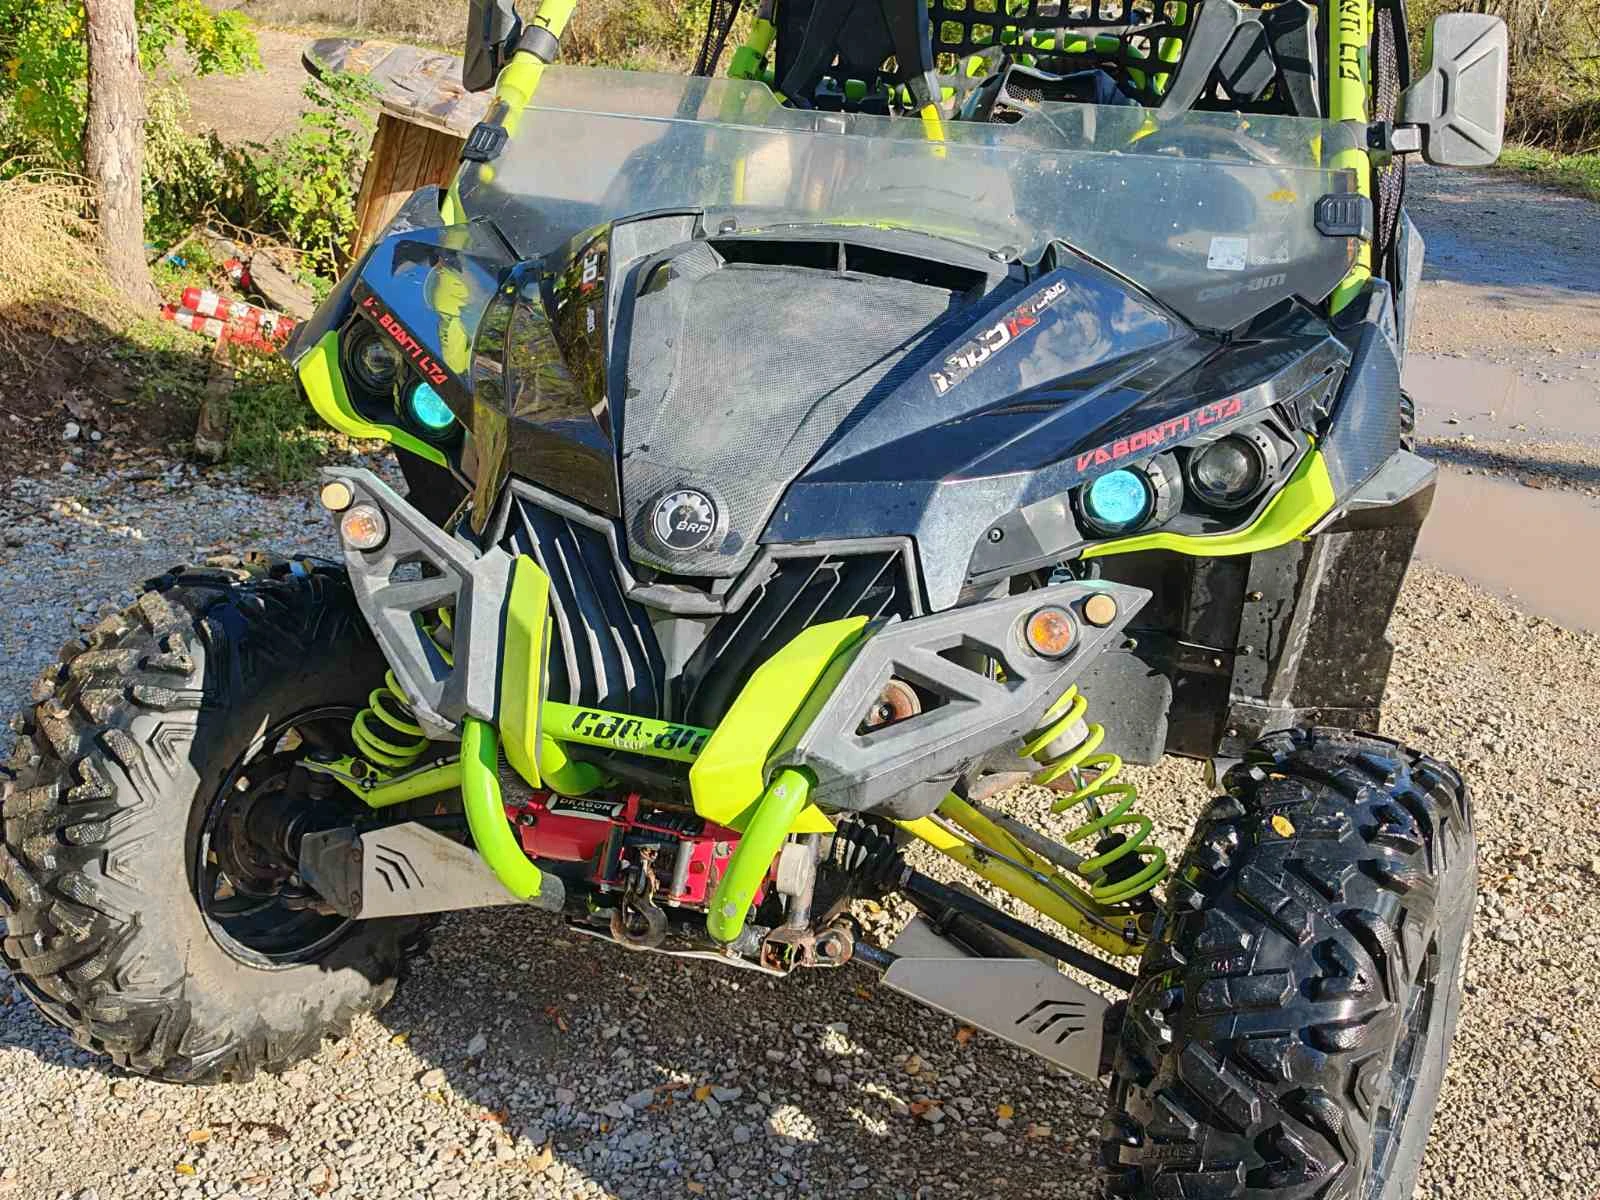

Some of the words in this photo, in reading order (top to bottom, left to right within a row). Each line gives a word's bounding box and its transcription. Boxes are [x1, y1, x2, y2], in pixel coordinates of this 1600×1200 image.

[1076, 416, 1190, 472] VABONTI
[676, 521, 709, 533] BRP
[560, 798, 612, 811] DRAGON
